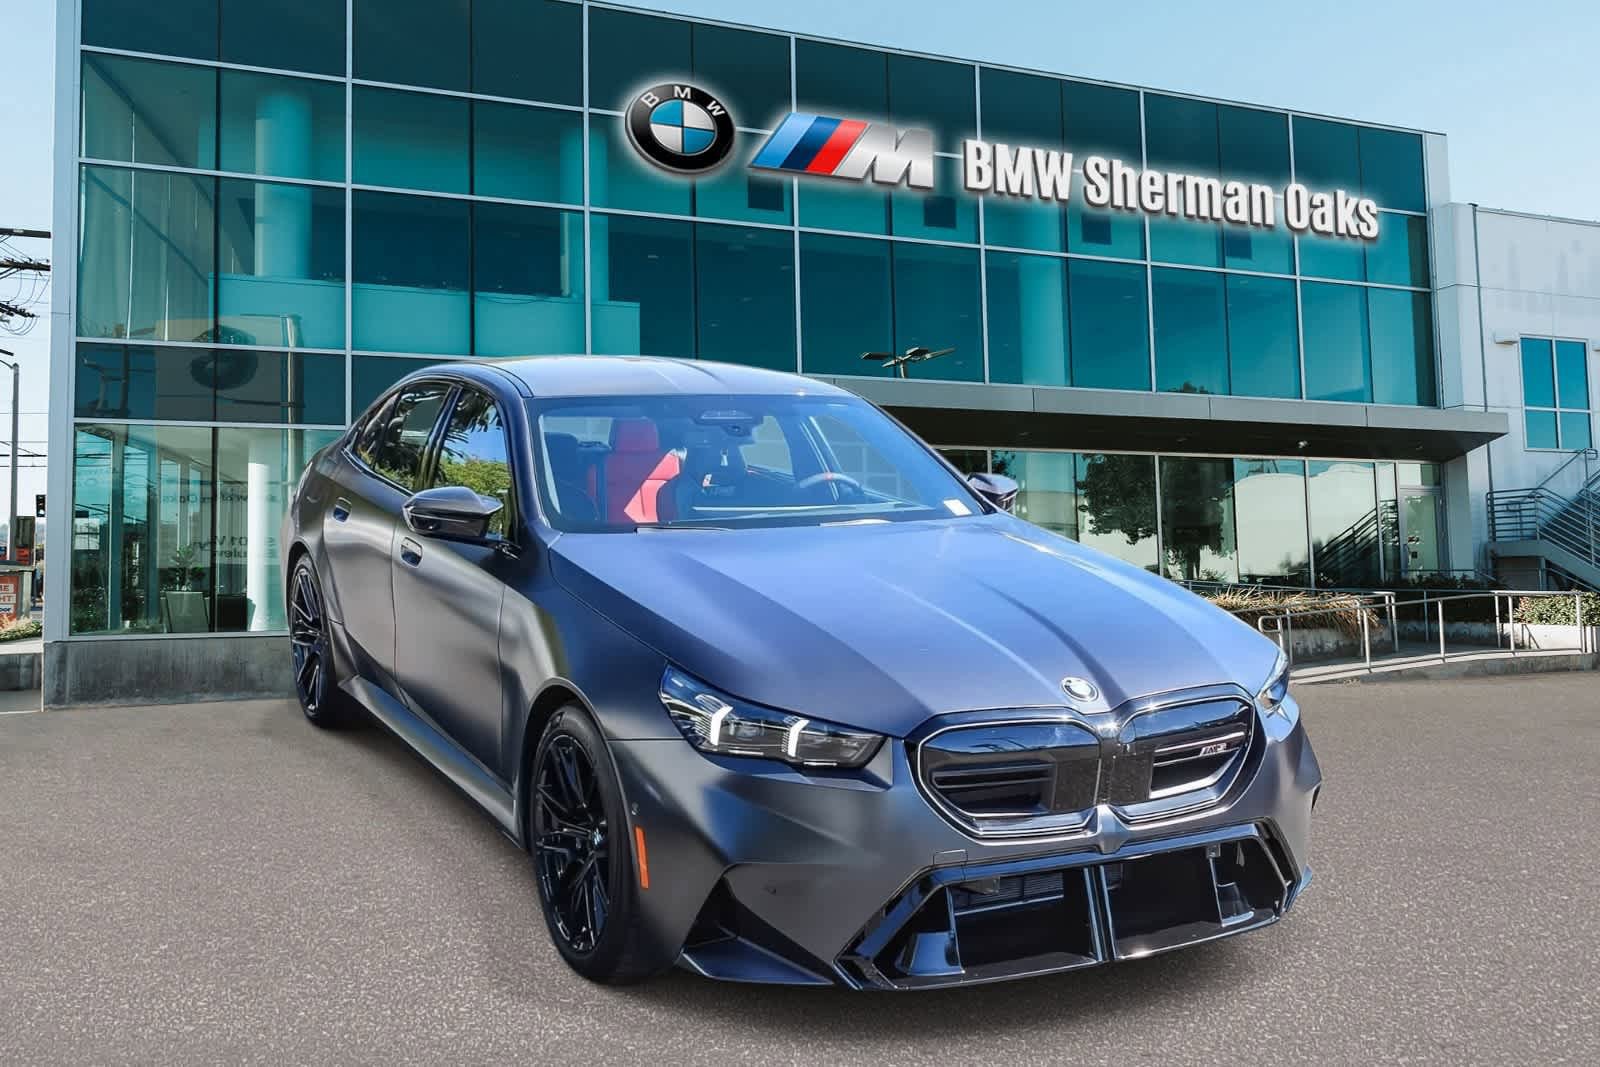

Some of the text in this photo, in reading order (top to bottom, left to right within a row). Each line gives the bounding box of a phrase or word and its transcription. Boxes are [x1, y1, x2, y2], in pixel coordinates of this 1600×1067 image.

[640, 85, 725, 117] BMW
[964, 139, 1379, 240] BMW Sherman Oaks
